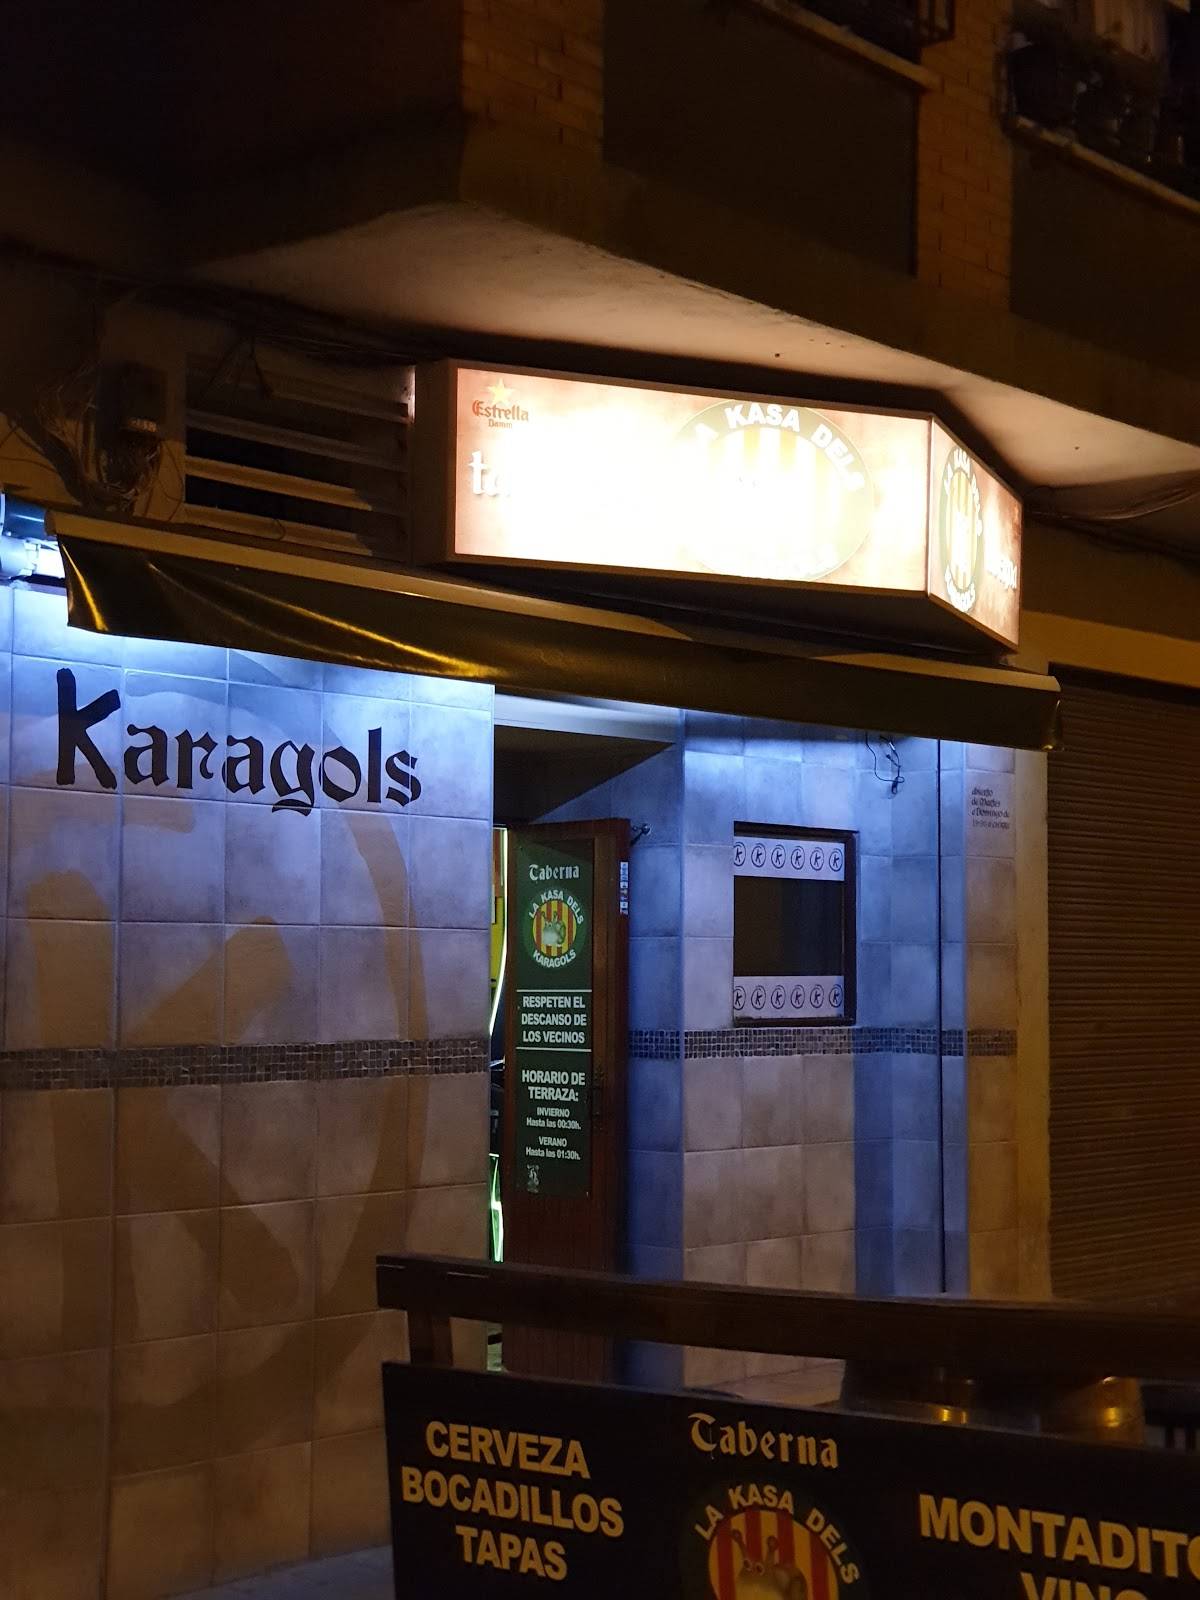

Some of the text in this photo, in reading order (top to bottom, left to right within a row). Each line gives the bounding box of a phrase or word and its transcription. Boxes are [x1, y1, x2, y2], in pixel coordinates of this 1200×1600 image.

[472, 400, 529, 421] Estrella
[724, 403, 800, 432] KASA
[56, 668, 422, 817] Karagols
[529, 864, 580, 881] Taberna
[529, 890, 585, 925] LA KASA DELS
[533, 949, 577, 969] KARAGOLS
[522, 996, 586, 1009] RESPETEN EL
[521, 1013, 587, 1026] DESCANSO DE
[523, 1031, 585, 1044] LOS VECINOS
[521, 1070, 586, 1086] HORARIO DE
[528, 1086, 579, 1102] TERRAZA:
[536, 1106, 570, 1118] INVIERNO
[526, 1117, 545, 1127] Hasta
[546, 1118, 556, 1128] las
[538, 1136, 567, 1147] VERANO
[525, 1147, 545, 1157] Hasta
[546, 1148, 555, 1158] las
[425, 1420, 591, 1479] CERVEZA
[688, 1412, 839, 1469] Taberna
[401, 1465, 624, 1538] BOCADILLOS
[694, 1482, 860, 1584] LA KASA DELS
[455, 1524, 568, 1581] TAPAS
